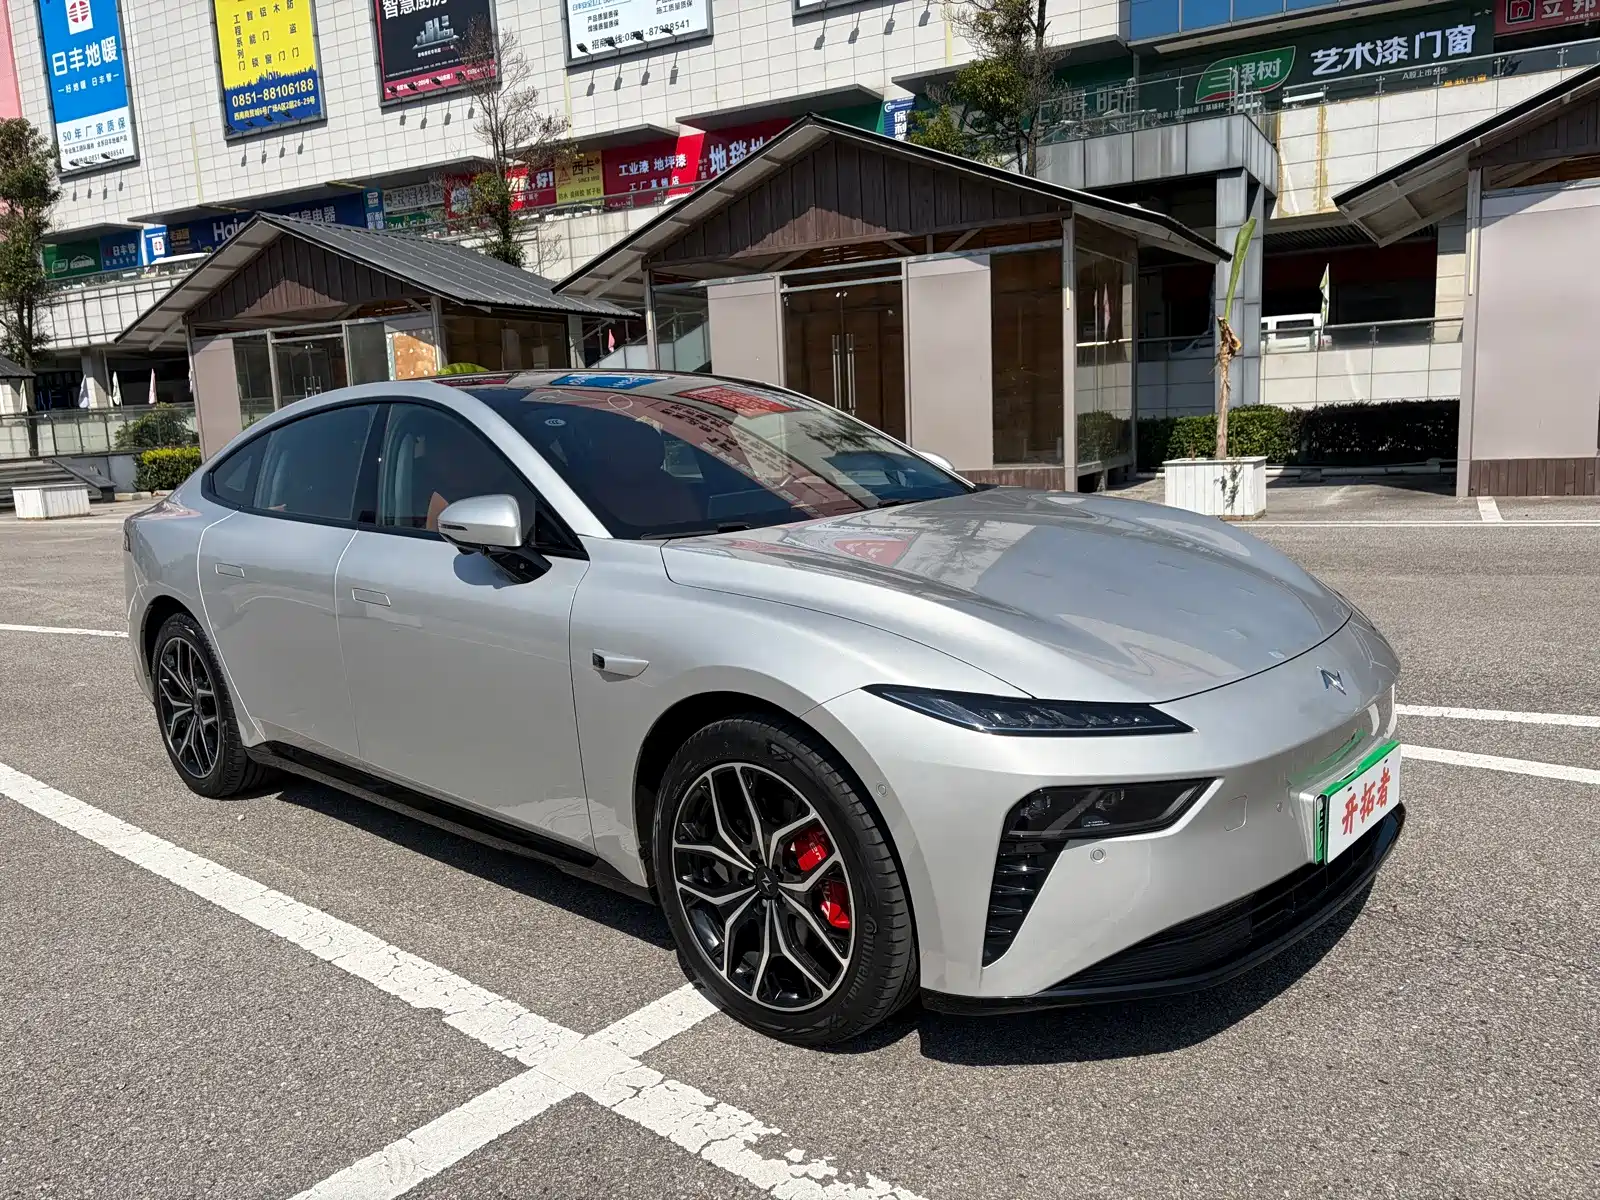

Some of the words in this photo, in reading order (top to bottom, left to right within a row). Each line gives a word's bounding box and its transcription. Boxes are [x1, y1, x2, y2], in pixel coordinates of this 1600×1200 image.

[52, 36, 118, 77] 日丰地暖
[1311, 24, 1476, 76] 艺术漆门窗
[232, 78, 314, 108] 0851-88106188
[1208, 58, 1282, 89] 三棵树
[618, 160, 650, 177] 工业漆
[653, 153, 687, 171] 地坪漆
[1342, 767, 1391, 835] 开拓者
[846, 913, 878, 1001] Continental
